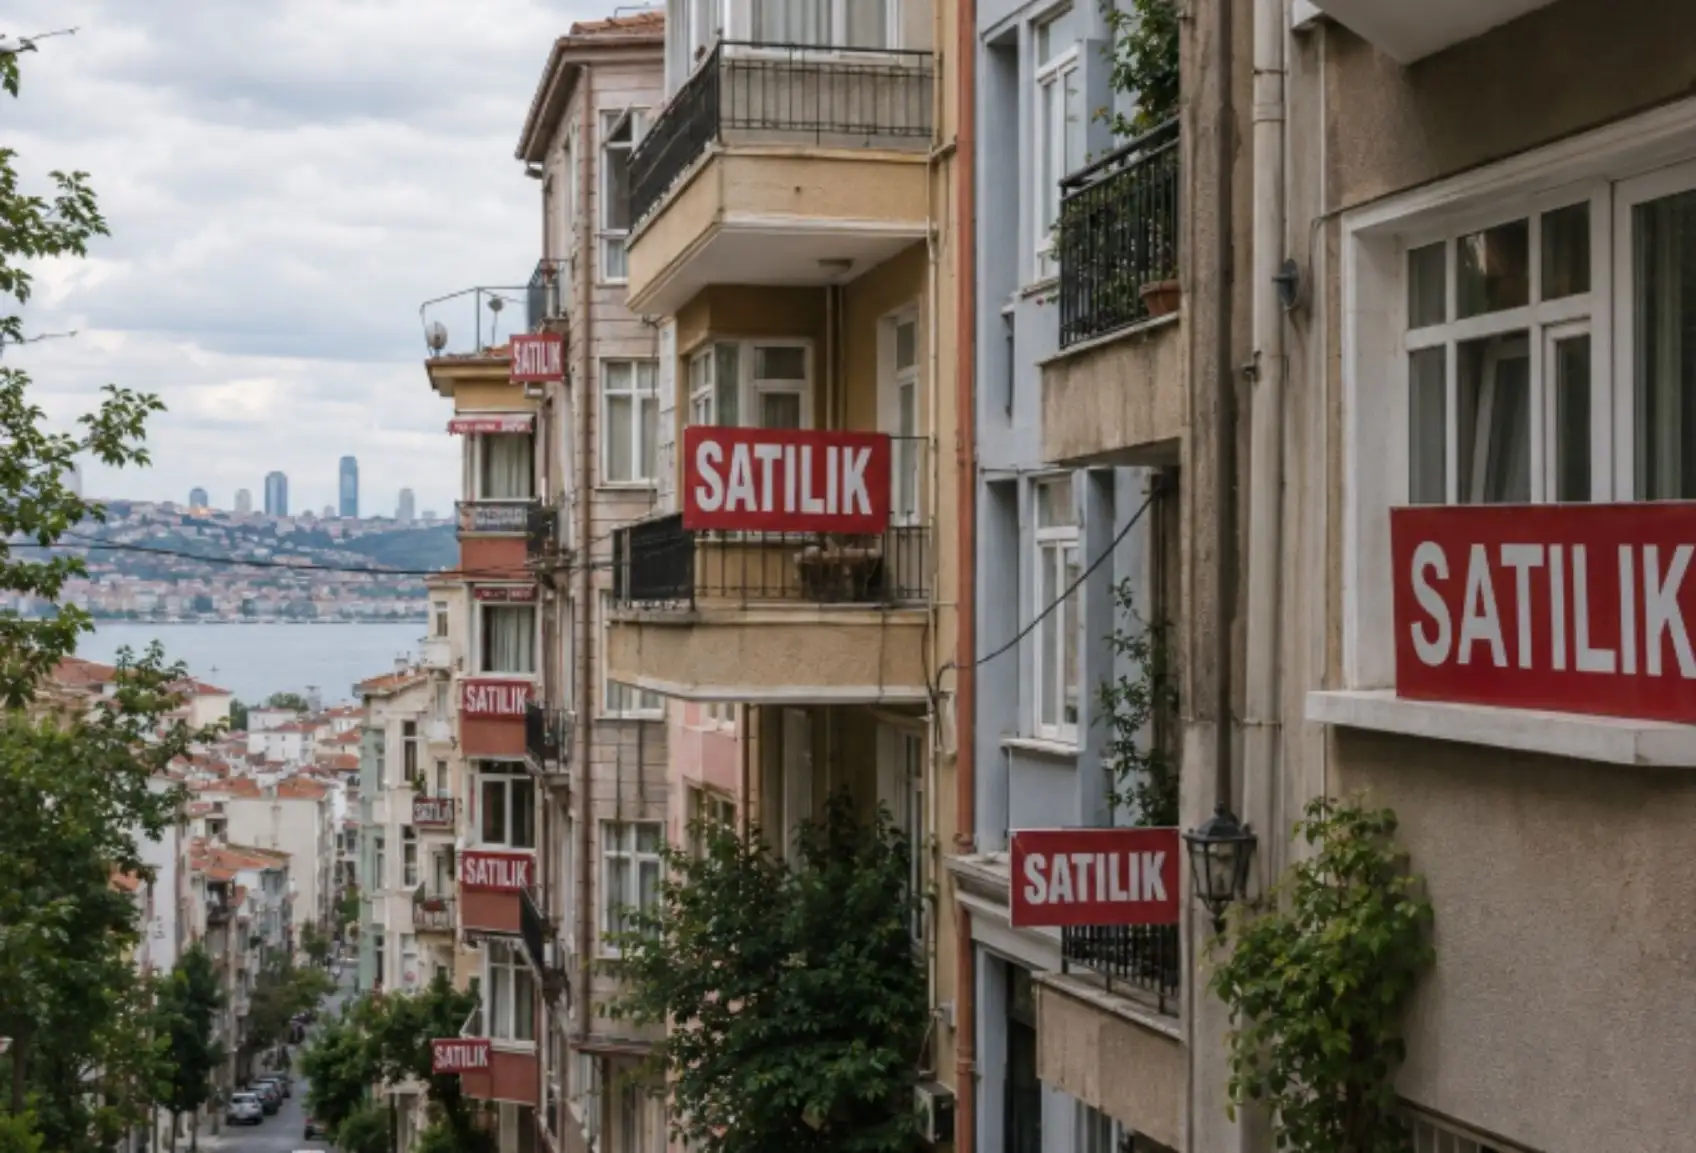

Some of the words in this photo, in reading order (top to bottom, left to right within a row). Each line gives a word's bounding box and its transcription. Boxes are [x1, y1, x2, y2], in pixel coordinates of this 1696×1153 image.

[695, 440, 873, 516] SATILIK
[1410, 541, 1696, 679] SATILIK
[466, 685, 528, 714] SATILIK
[465, 857, 528, 887] SATILIK
[1024, 851, 1167, 905] SATILIK
[434, 1045, 488, 1069] SATILIK
